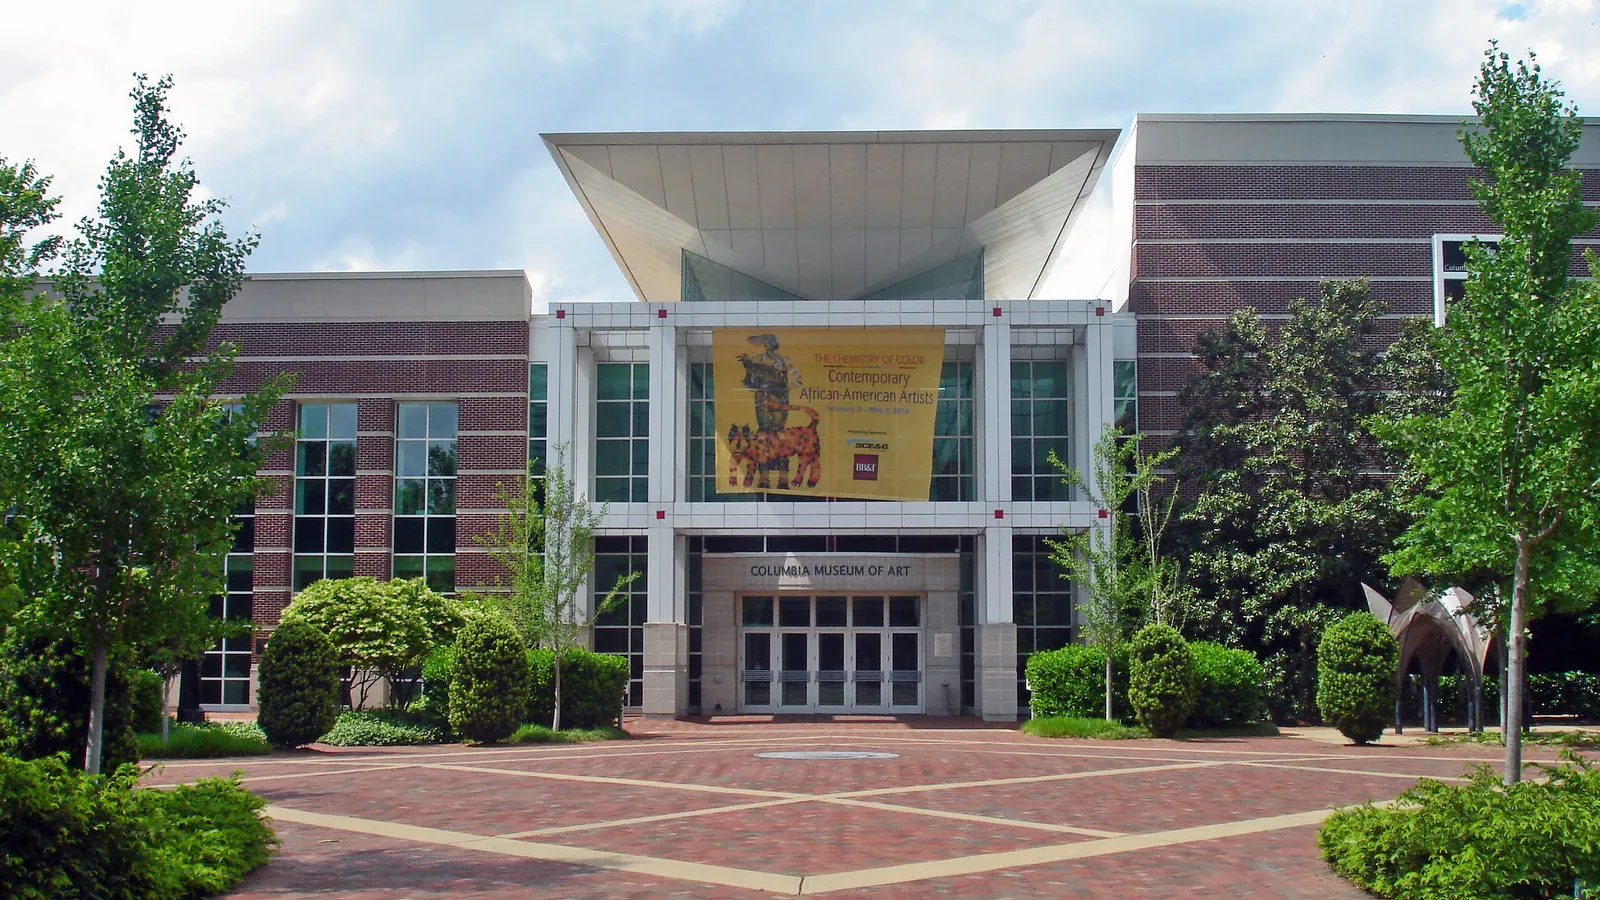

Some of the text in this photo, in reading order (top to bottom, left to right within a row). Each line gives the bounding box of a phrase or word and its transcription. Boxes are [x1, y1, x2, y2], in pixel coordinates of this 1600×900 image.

[1444, 264, 1467, 272] Colum
[814, 354, 926, 365] THE CHEMISTRY OF COLOR
[828, 369, 911, 388] Contemporary
[799, 387, 934, 405] African-American Artists
[855, 442, 889, 450] SCE&G
[856, 463, 876, 472] BB&T
[750, 565, 911, 577] COLUMBIA MUSEUM OF ART
